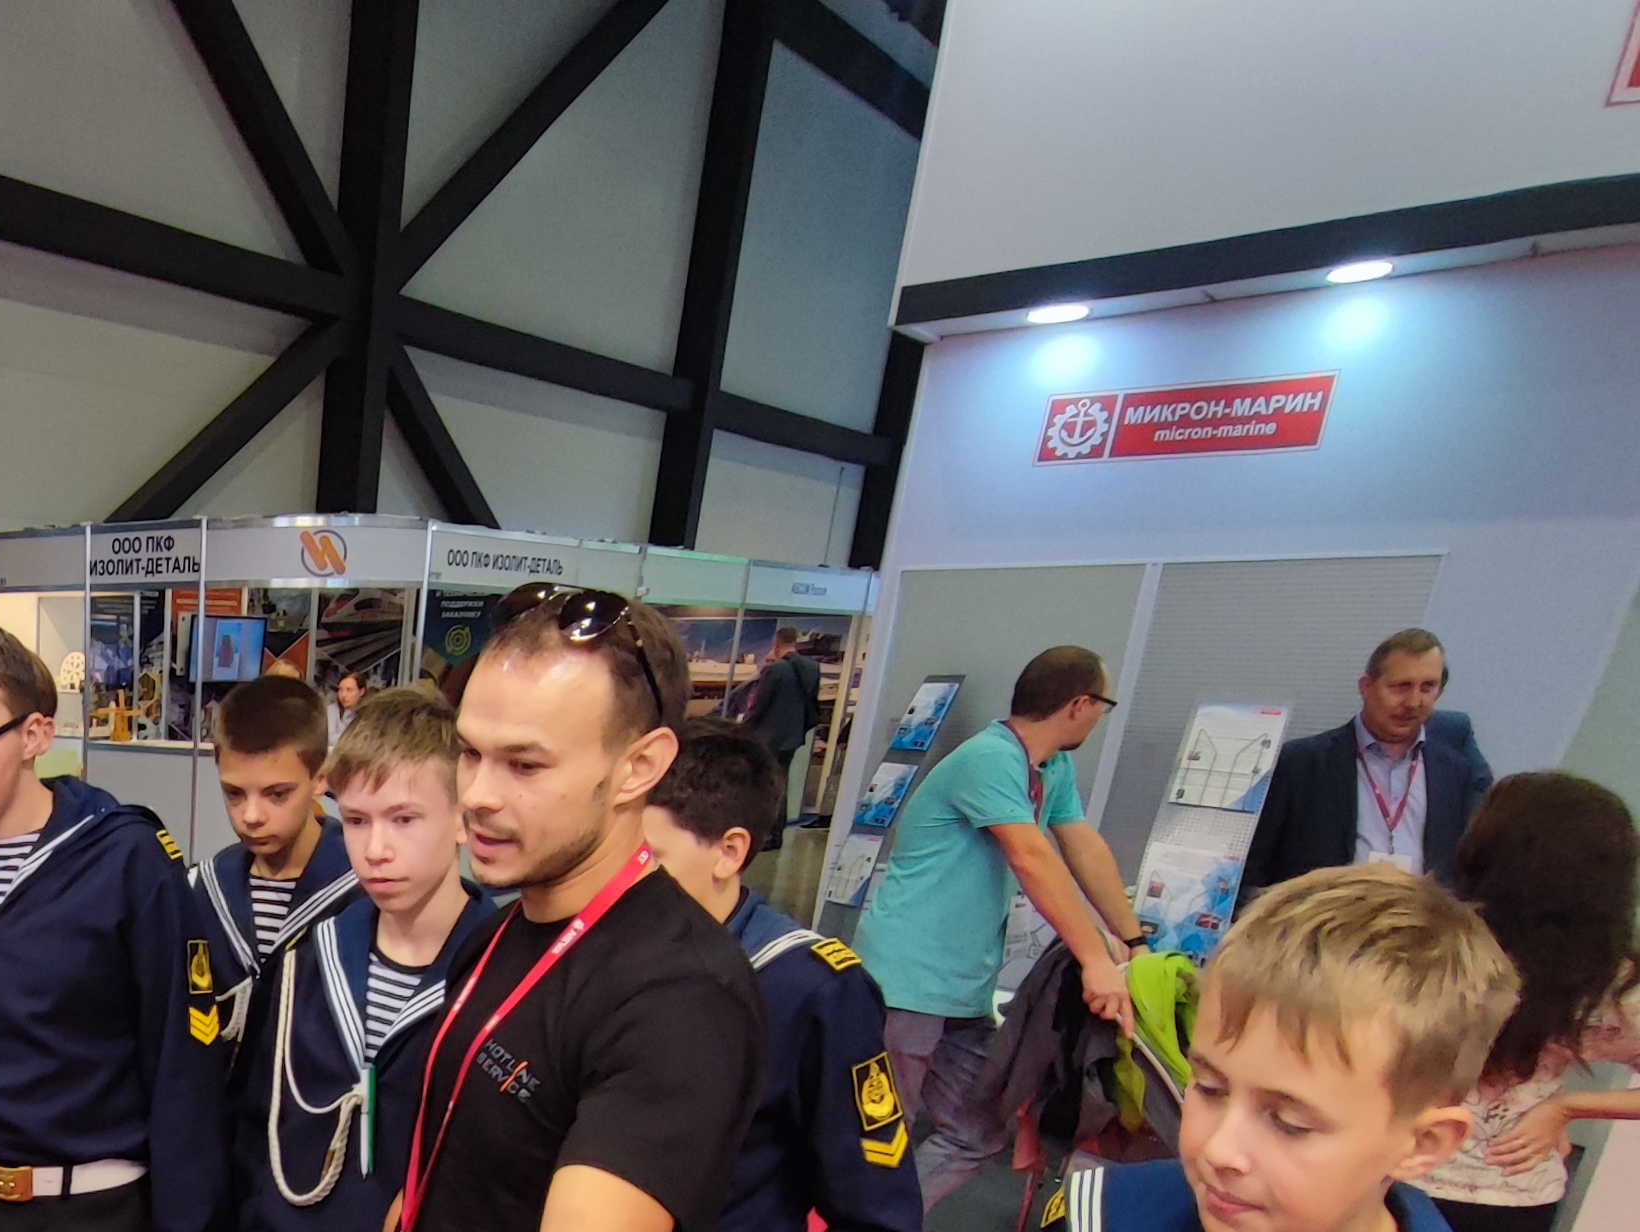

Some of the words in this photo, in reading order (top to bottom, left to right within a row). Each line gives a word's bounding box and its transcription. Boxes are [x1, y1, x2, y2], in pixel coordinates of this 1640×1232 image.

[1124, 391, 1323, 425] МИКРОН-МАРИН
[1153, 420, 1277, 442] micron-marine
[112, 536, 142, 554] ООО
[146, 535, 175, 553] ПКФ
[89, 556, 200, 577] ИЗОЛИТ-ДЕТАЛЬ
[447, 549, 469, 567] ООО
[471, 551, 490, 568] ПКФ
[492, 553, 563, 576] ИЗОЛИТ-ДЕТАЛЬ
